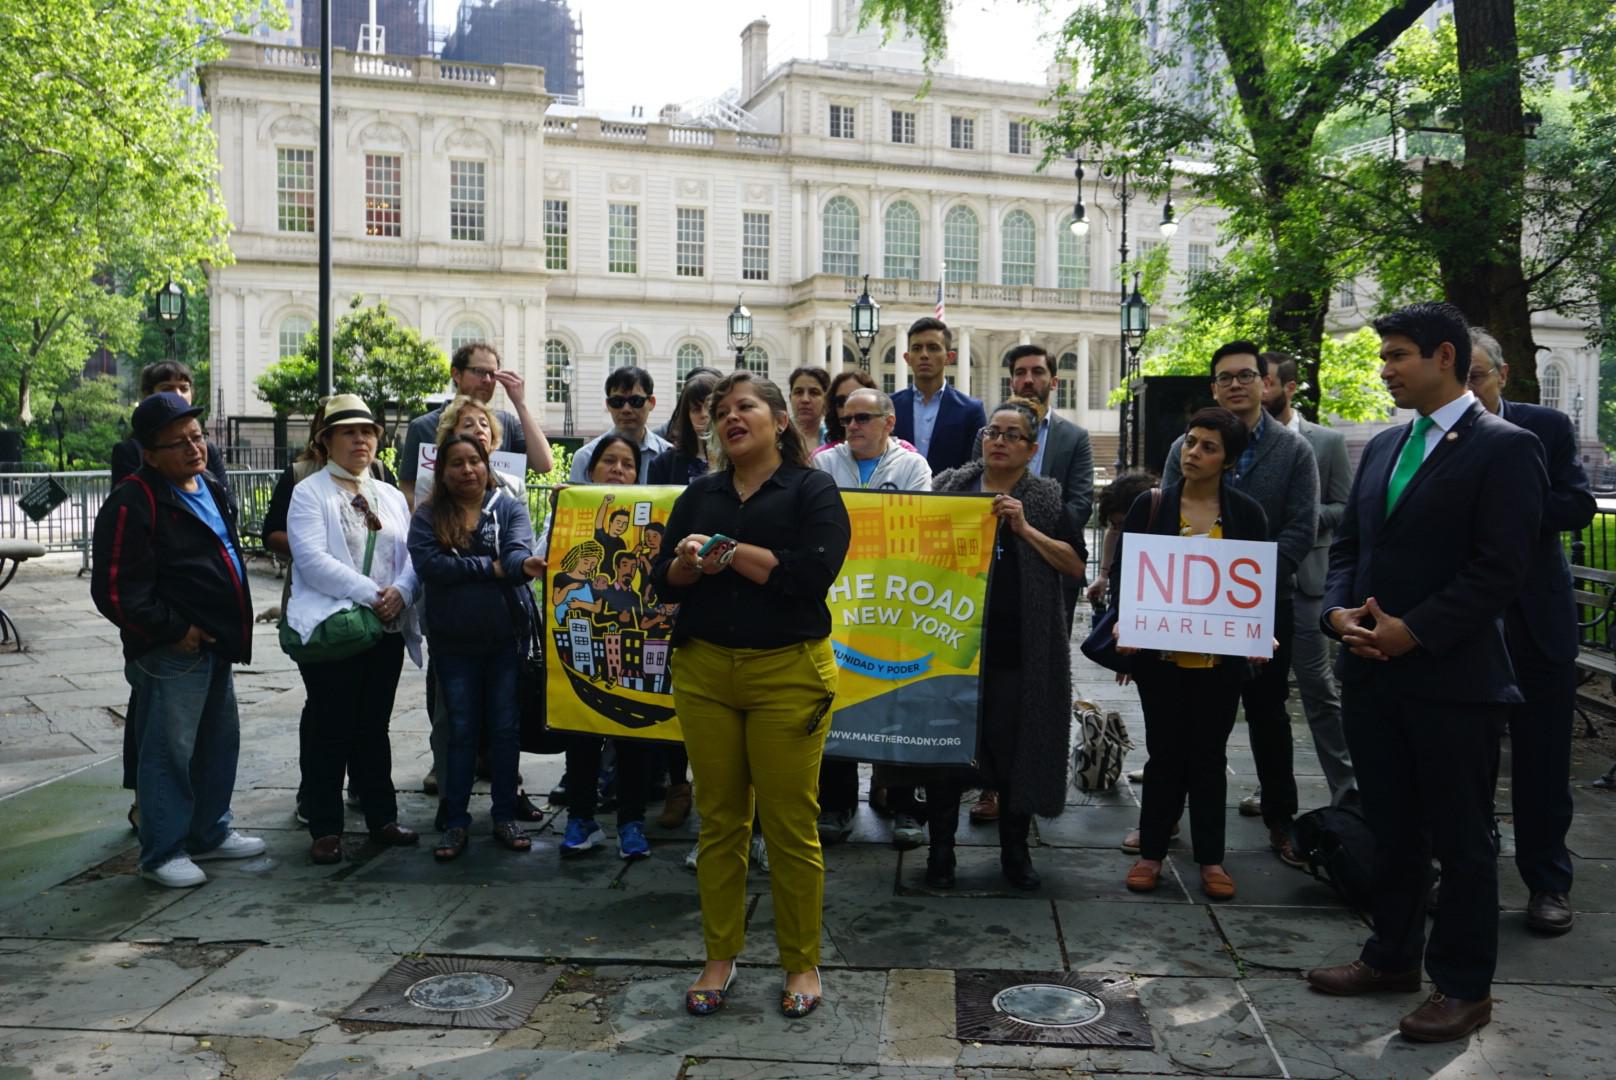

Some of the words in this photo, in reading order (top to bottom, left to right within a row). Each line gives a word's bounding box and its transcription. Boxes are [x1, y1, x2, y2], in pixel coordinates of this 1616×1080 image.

[829, 574, 875, 603] HE
[885, 575, 975, 621] ROAD
[1137, 551, 1262, 609] NDS
[843, 606, 903, 625] NEW
[911, 611, 966, 649] YORK
[1135, 615, 1261, 639] HARLEM
[834, 649, 875, 671] UNIDAD
[887, 664, 920, 674] PODER
